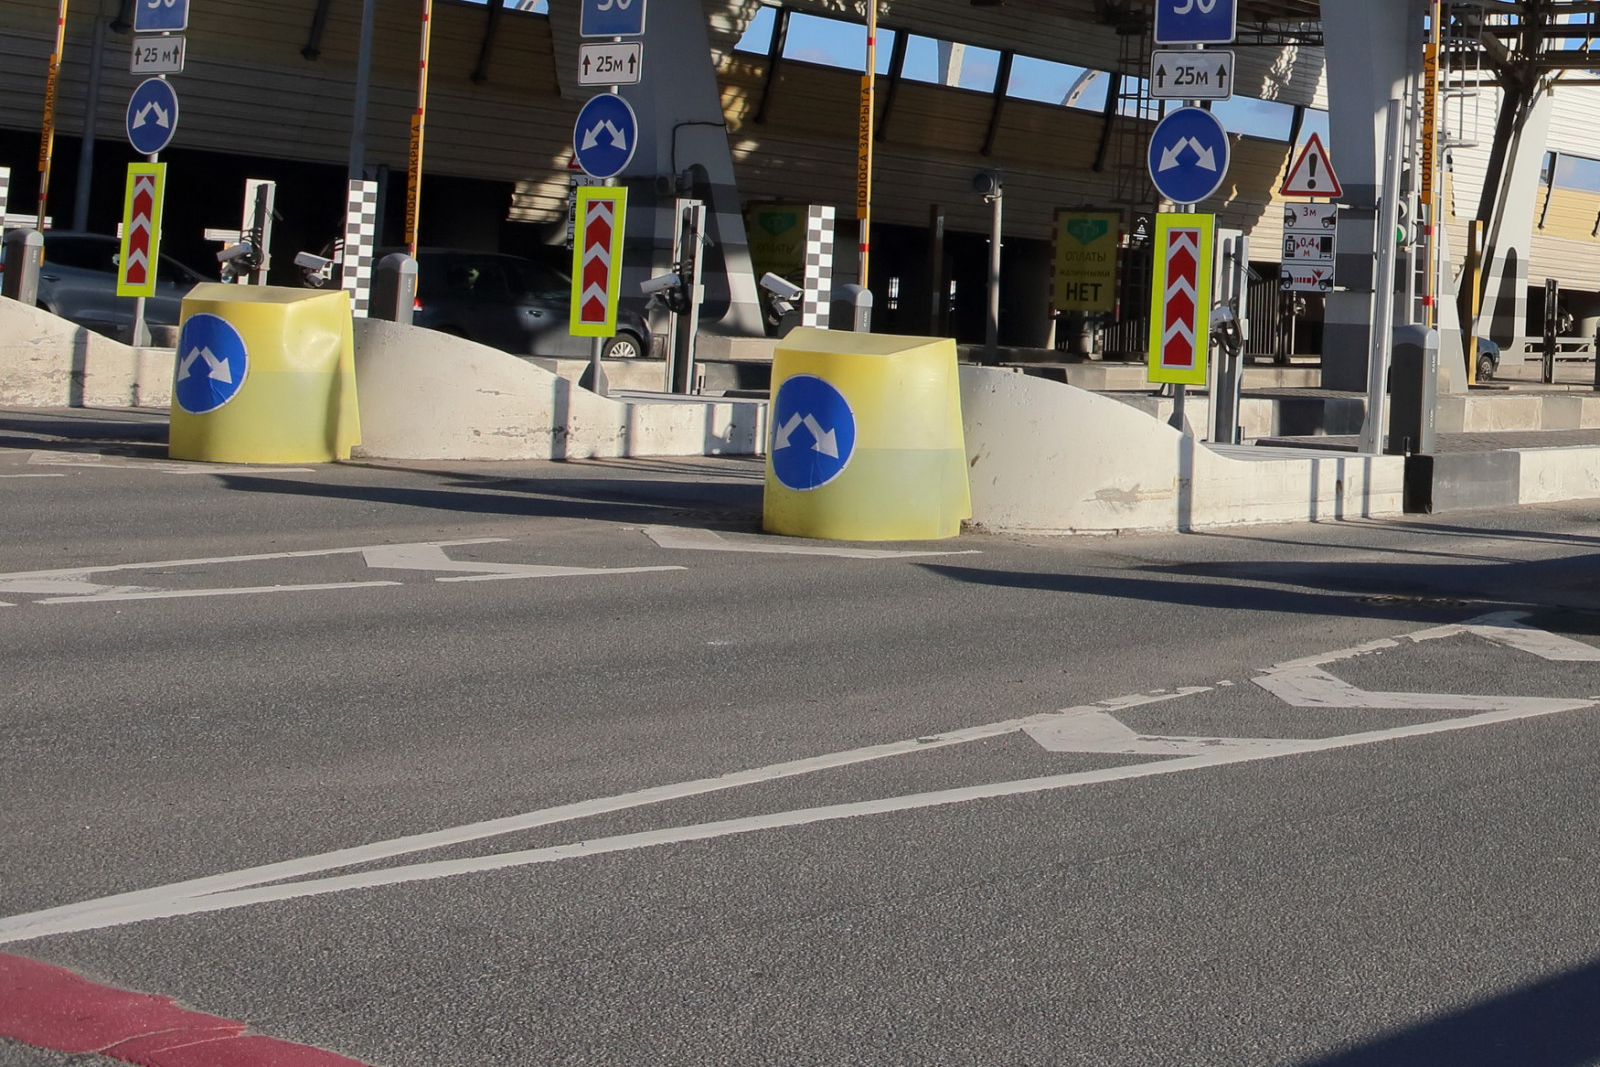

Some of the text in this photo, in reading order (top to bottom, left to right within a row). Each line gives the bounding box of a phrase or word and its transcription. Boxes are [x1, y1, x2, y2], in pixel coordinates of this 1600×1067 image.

[858, 87, 870, 208] ПОЛОСА ЗАКРЫТА
[1422, 55, 1436, 192] ПОЛОСА ЗАКРЫТА
[1066, 282, 1103, 302] НЕТ
